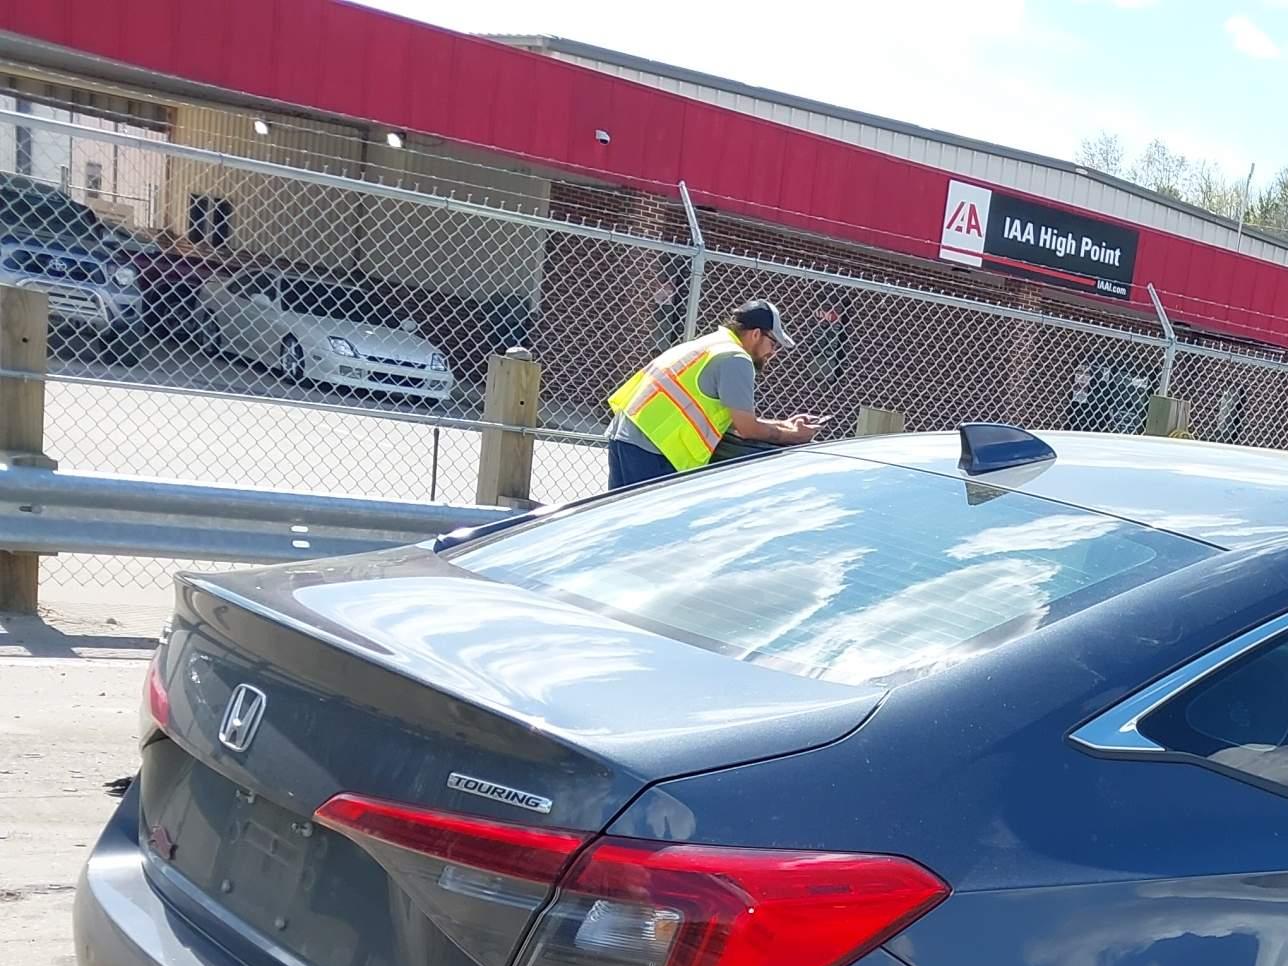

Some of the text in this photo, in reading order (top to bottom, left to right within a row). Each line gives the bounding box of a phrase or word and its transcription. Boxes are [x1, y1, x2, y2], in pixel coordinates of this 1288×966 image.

[1003, 216, 1122, 267] IAA High Point
[454, 776, 542, 808] TOURING
